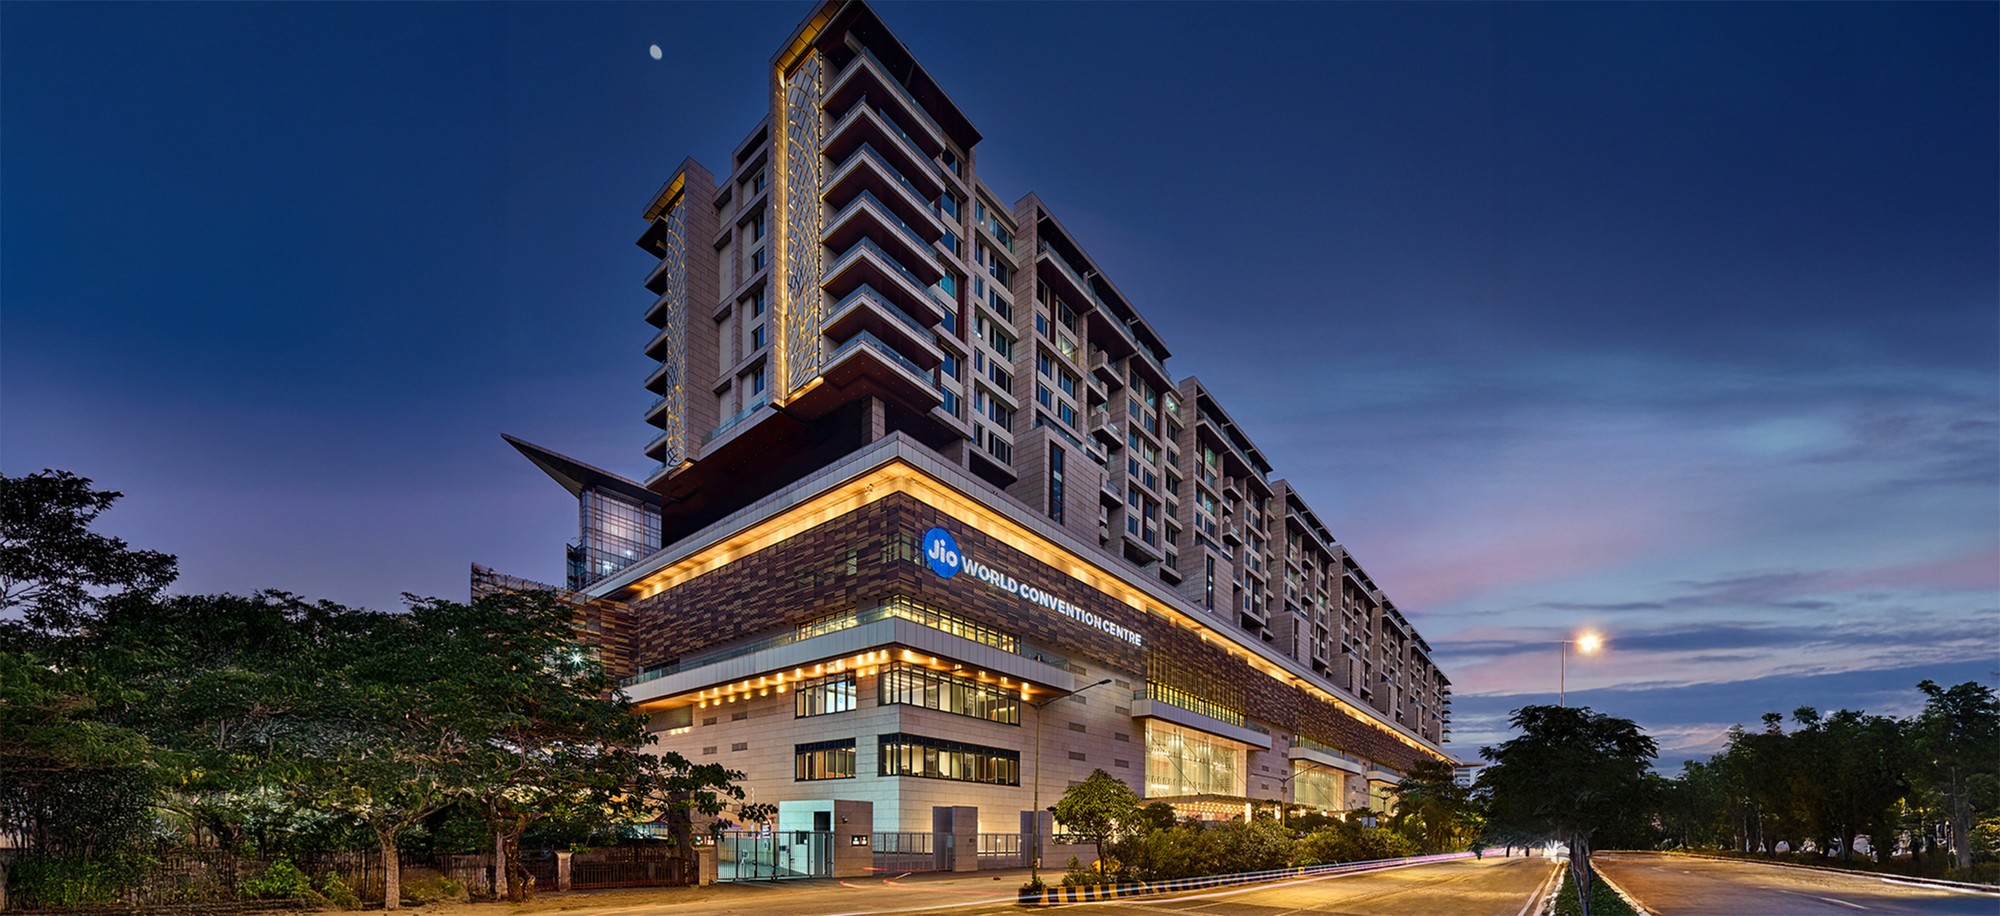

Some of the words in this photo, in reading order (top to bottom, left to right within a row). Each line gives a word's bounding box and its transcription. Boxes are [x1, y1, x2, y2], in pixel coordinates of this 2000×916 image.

[928, 539, 958, 567] Jio
[962, 556, 1018, 593] WORLD
[1020, 583, 1102, 630] CONVENTION
[1103, 619, 1142, 647] CENTRE
